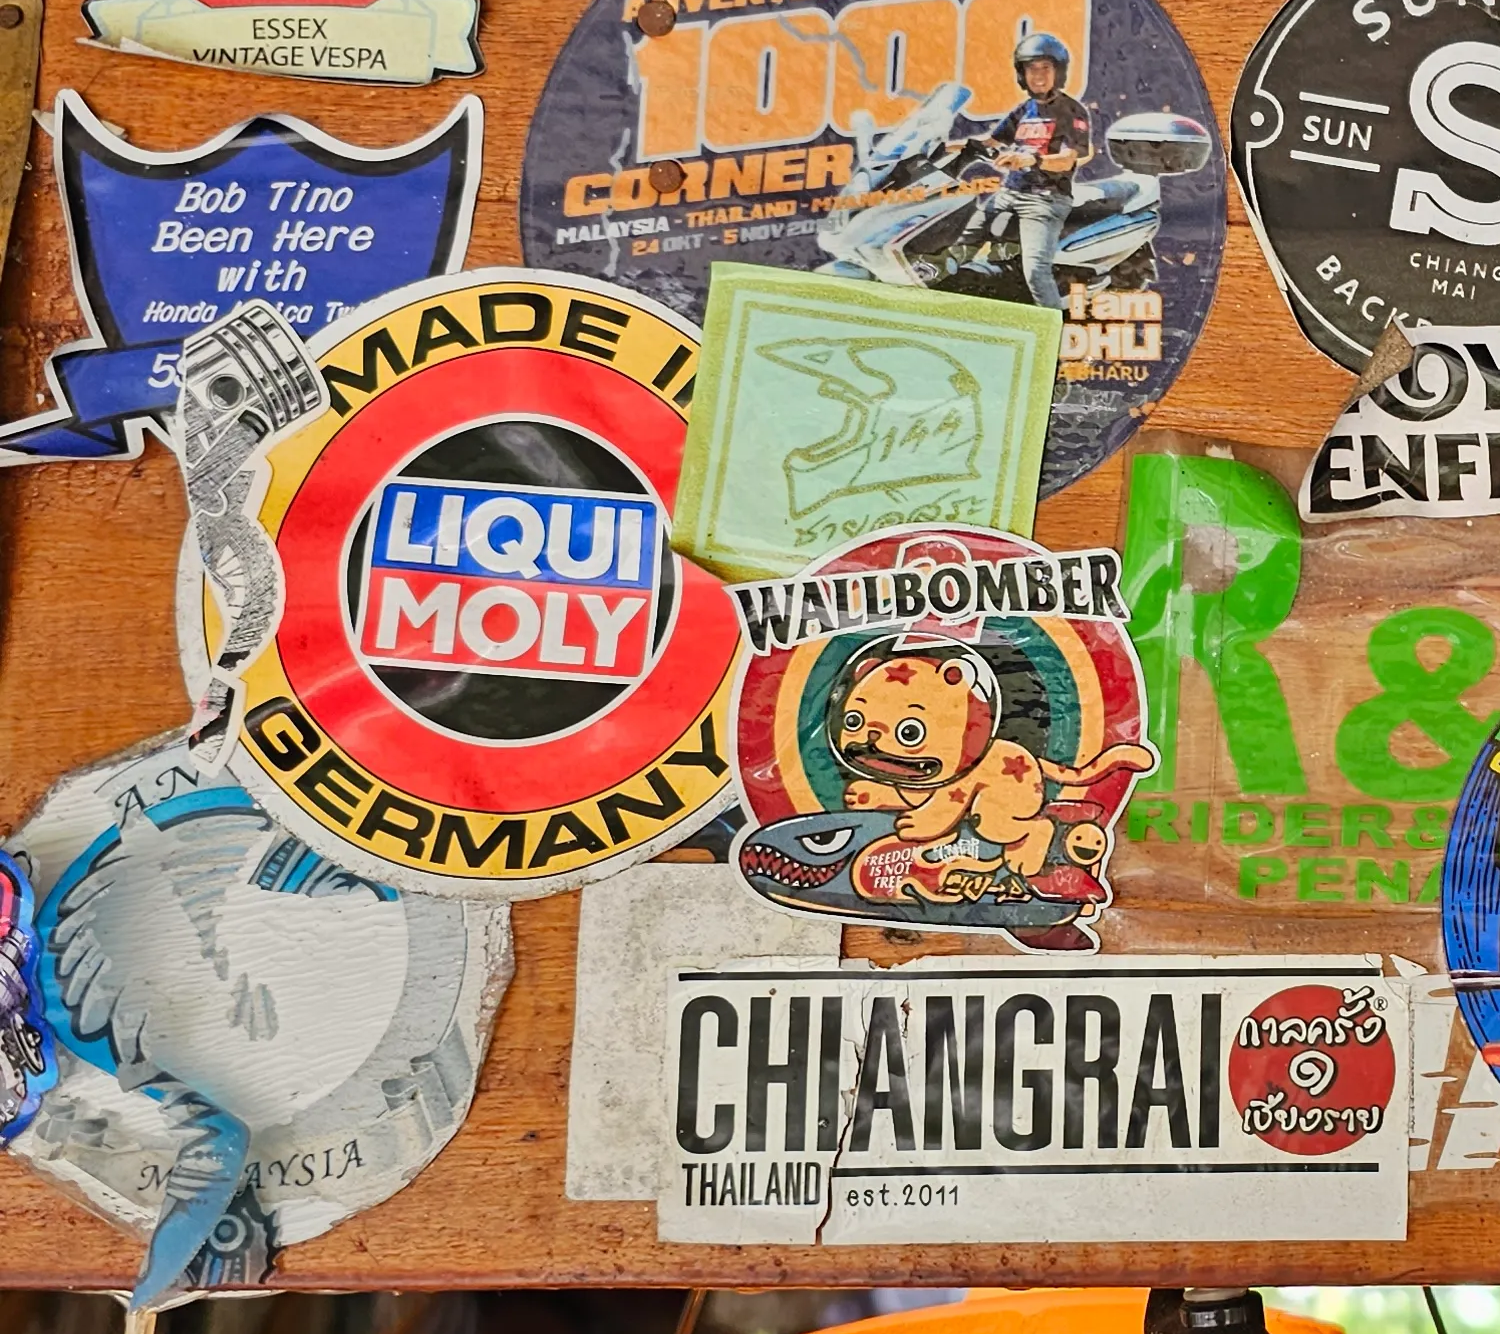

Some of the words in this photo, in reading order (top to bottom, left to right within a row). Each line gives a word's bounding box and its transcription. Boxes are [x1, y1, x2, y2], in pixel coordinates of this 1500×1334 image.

[252, 19, 328, 40] ESSEX
[193, 46, 304, 68] VINTAGE
[311, 47, 388, 70] VESPA
[1302, 115, 1374, 152] SUN
[175, 181, 247, 214] Bob
[269, 181, 354, 214] Tino
[563, 143, 853, 218] CORNER
[151, 221, 252, 254] Been
[272, 221, 375, 253] Here
[556, 215, 671, 246] MALAYSIA
[685, 197, 798, 229] THAILAND
[631, 239, 660, 257] 24
[723, 229, 738, 247] 5
[217, 259, 309, 293] with
[1431, 279, 1477, 301] MAI
[143, 300, 218, 324] Honda
[1092, 291, 1164, 322] am
[321, 290, 633, 418] MADE
[385, 491, 643, 582] LIQUI
[735, 555, 1131, 651] WALLBOMBER
[374, 576, 648, 669] MOLY
[243, 694, 731, 871] GERMANY
[870, 866, 882, 876] IS
[885, 862, 912, 875] NOT
[874, 876, 903, 889] FREE
[1239, 987, 1386, 1047] กาลครั้ง
[677, 992, 1221, 1155] CHIANGRAI
[1242, 1091, 1383, 1134] เชียงราย
[682, 1162, 823, 1208] THAILAND
